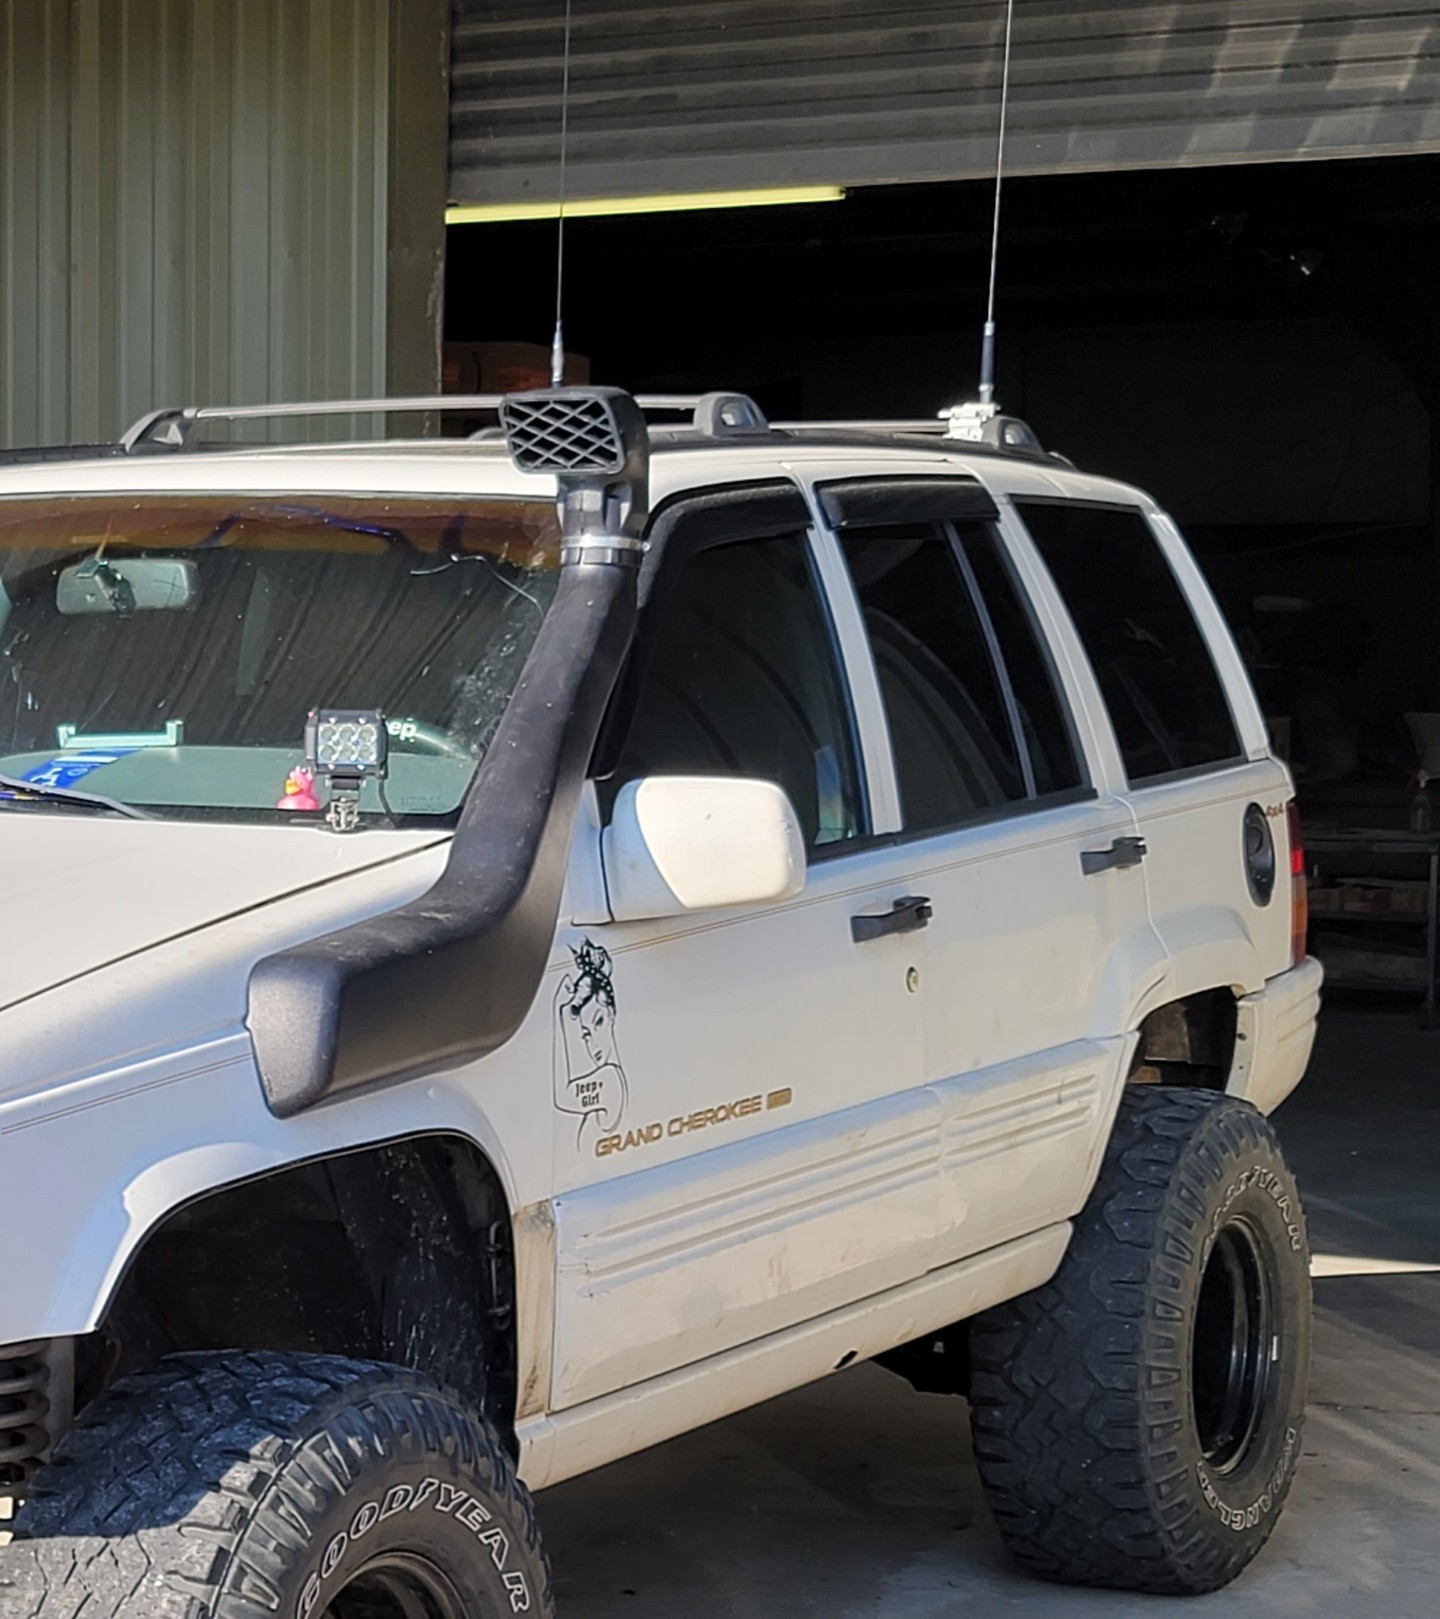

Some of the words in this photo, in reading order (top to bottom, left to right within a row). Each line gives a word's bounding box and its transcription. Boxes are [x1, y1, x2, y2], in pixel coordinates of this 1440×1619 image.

[386, 720, 417, 741] ep
[575, 1081, 597, 1098] Jeep
[581, 1092, 600, 1107] Girl
[595, 1122, 663, 1157] GRAND
[667, 1094, 762, 1137] CHEROKEE
[297, 1477, 530, 1619] GOODYEAR
